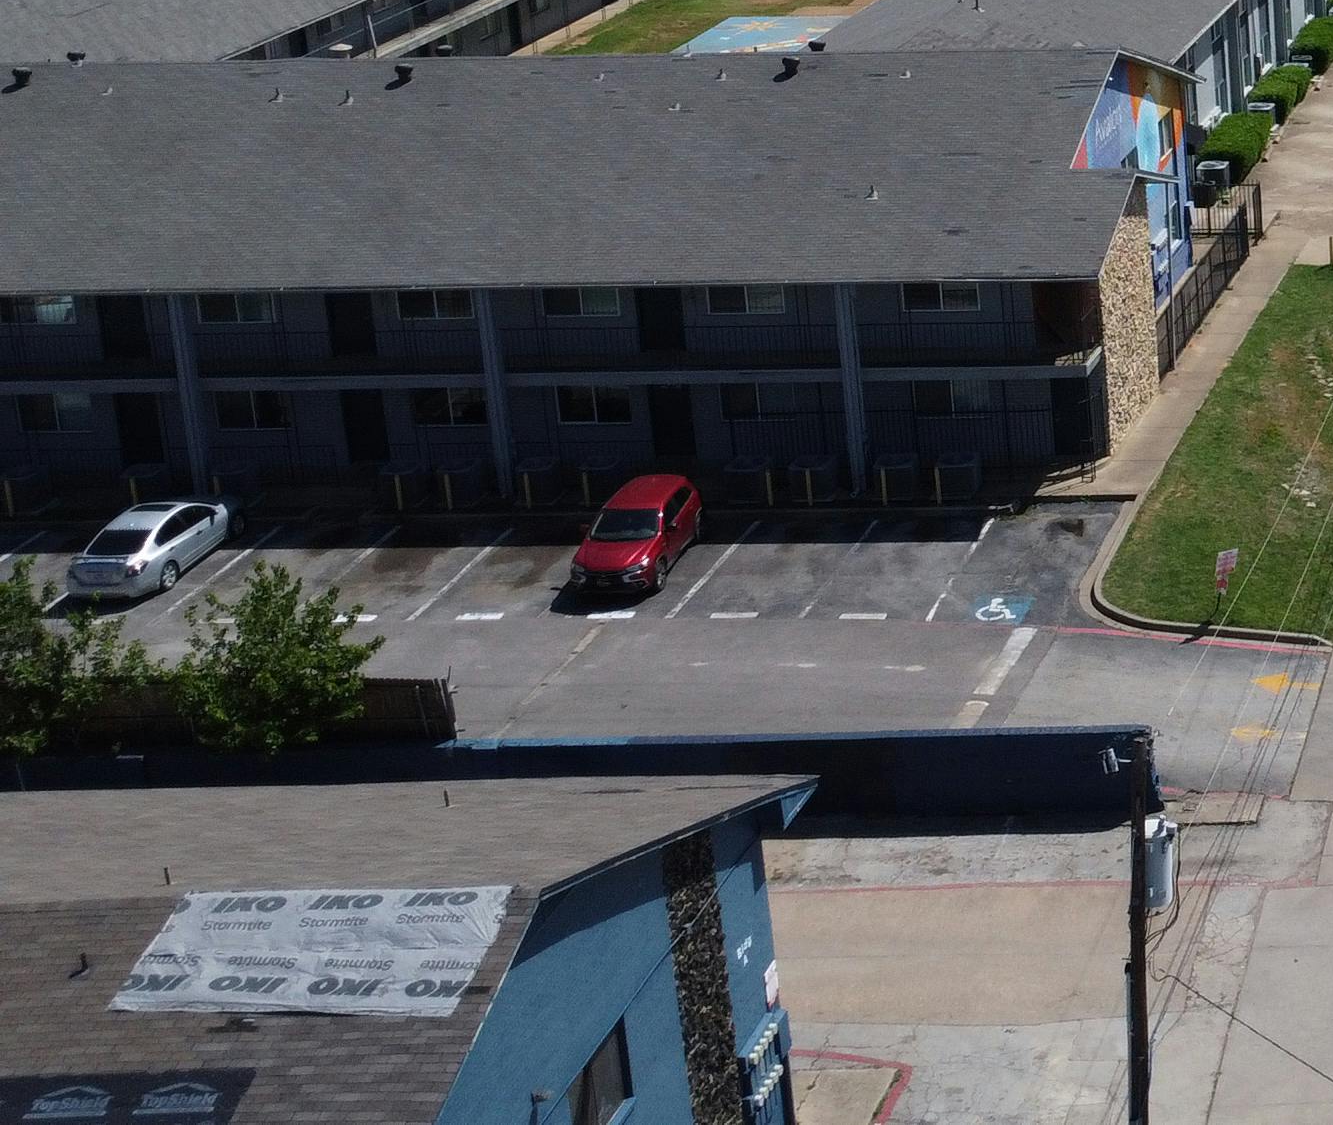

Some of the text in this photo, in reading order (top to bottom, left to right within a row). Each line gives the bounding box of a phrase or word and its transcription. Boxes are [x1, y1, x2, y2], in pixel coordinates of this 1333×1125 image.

[210, 896, 287, 913] IKO
[307, 893, 384, 910] IKO
[403, 891, 479, 907] IKO
[200, 913, 466, 932] Stormtite Stormtite Stormtite
[227, 955, 299, 970] Stormtite
[324, 957, 395, 972] Stormtite
[419, 958, 480, 972] tormtite
[208, 975, 289, 994] IKO
[306, 976, 386, 997] IKO
[405, 978, 469, 998] KO
